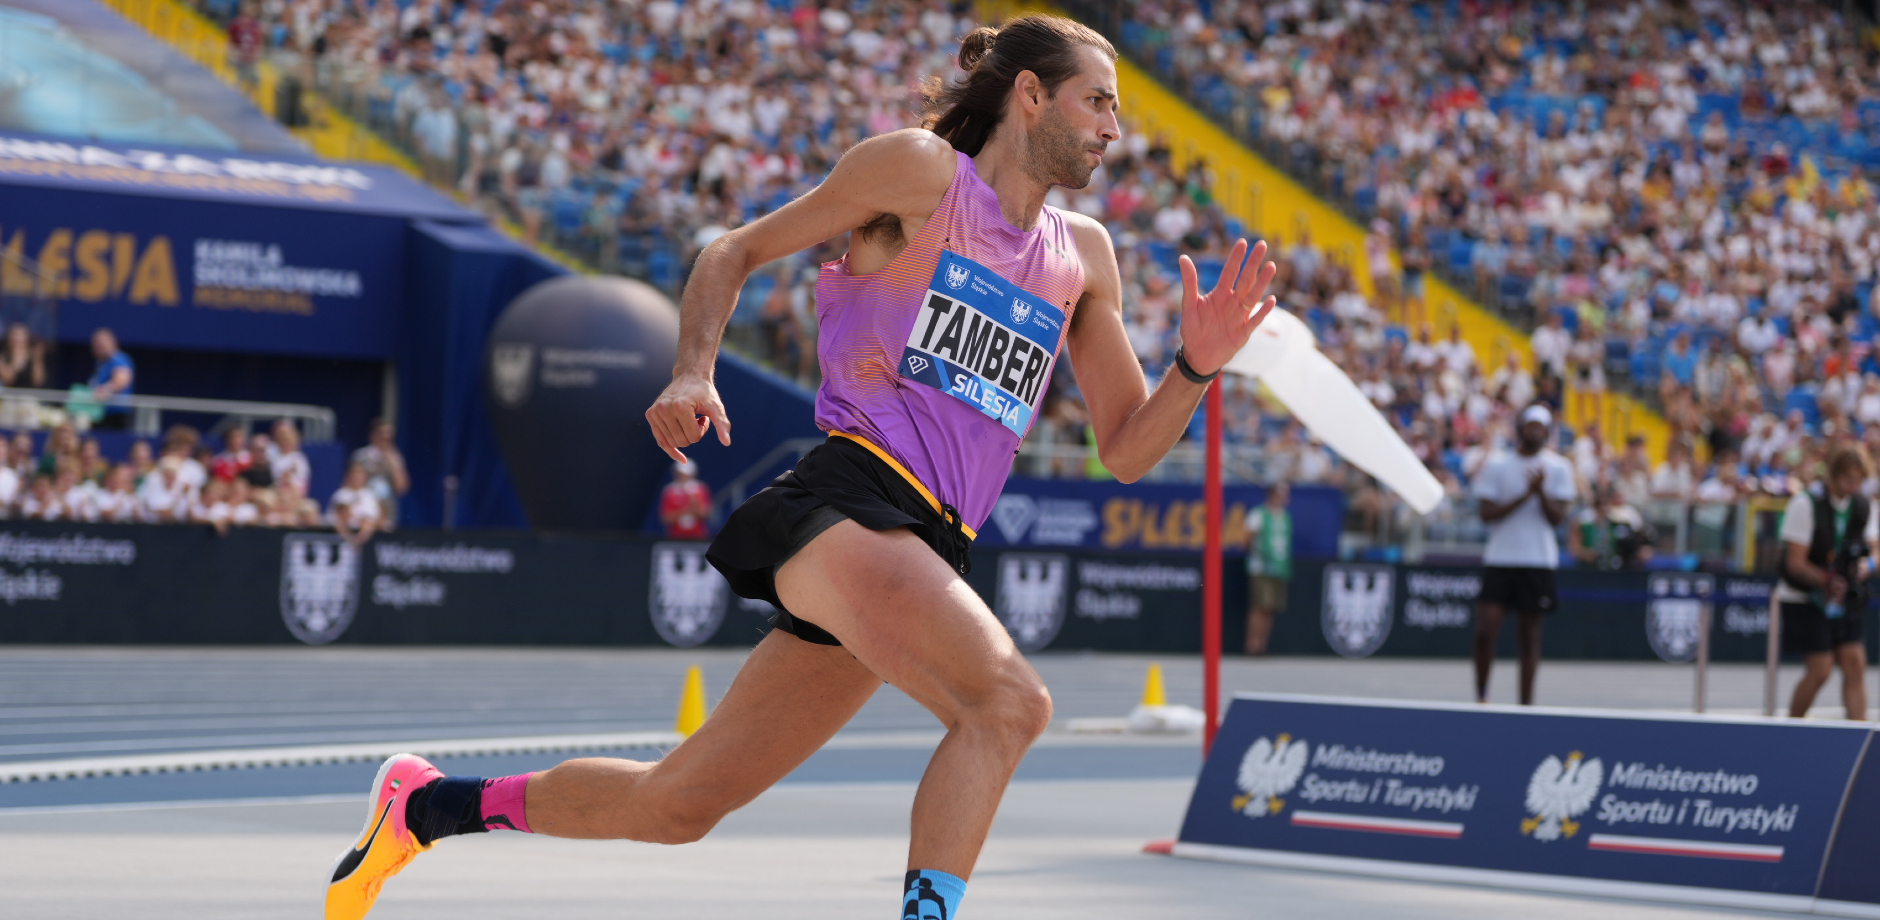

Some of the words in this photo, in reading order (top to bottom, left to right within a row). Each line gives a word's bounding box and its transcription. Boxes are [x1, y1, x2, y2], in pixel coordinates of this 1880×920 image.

[0, 226, 181, 306] LESIA
[920, 294, 1050, 407] TAMBERI
[952, 373, 1019, 426] SILESIA
[1103, 497, 1248, 549] SILESA
[1311, 744, 1445, 777] Ministerstwo
[1608, 761, 1759, 795] Ministerstwo
[1299, 773, 1369, 804] Sportu
[1369, 778, 1383, 804] i
[1384, 779, 1480, 814] Turystyki
[1596, 793, 1675, 826] Sportu
[1676, 798, 1690, 826] i
[1693, 799, 1799, 836] Turystyki
